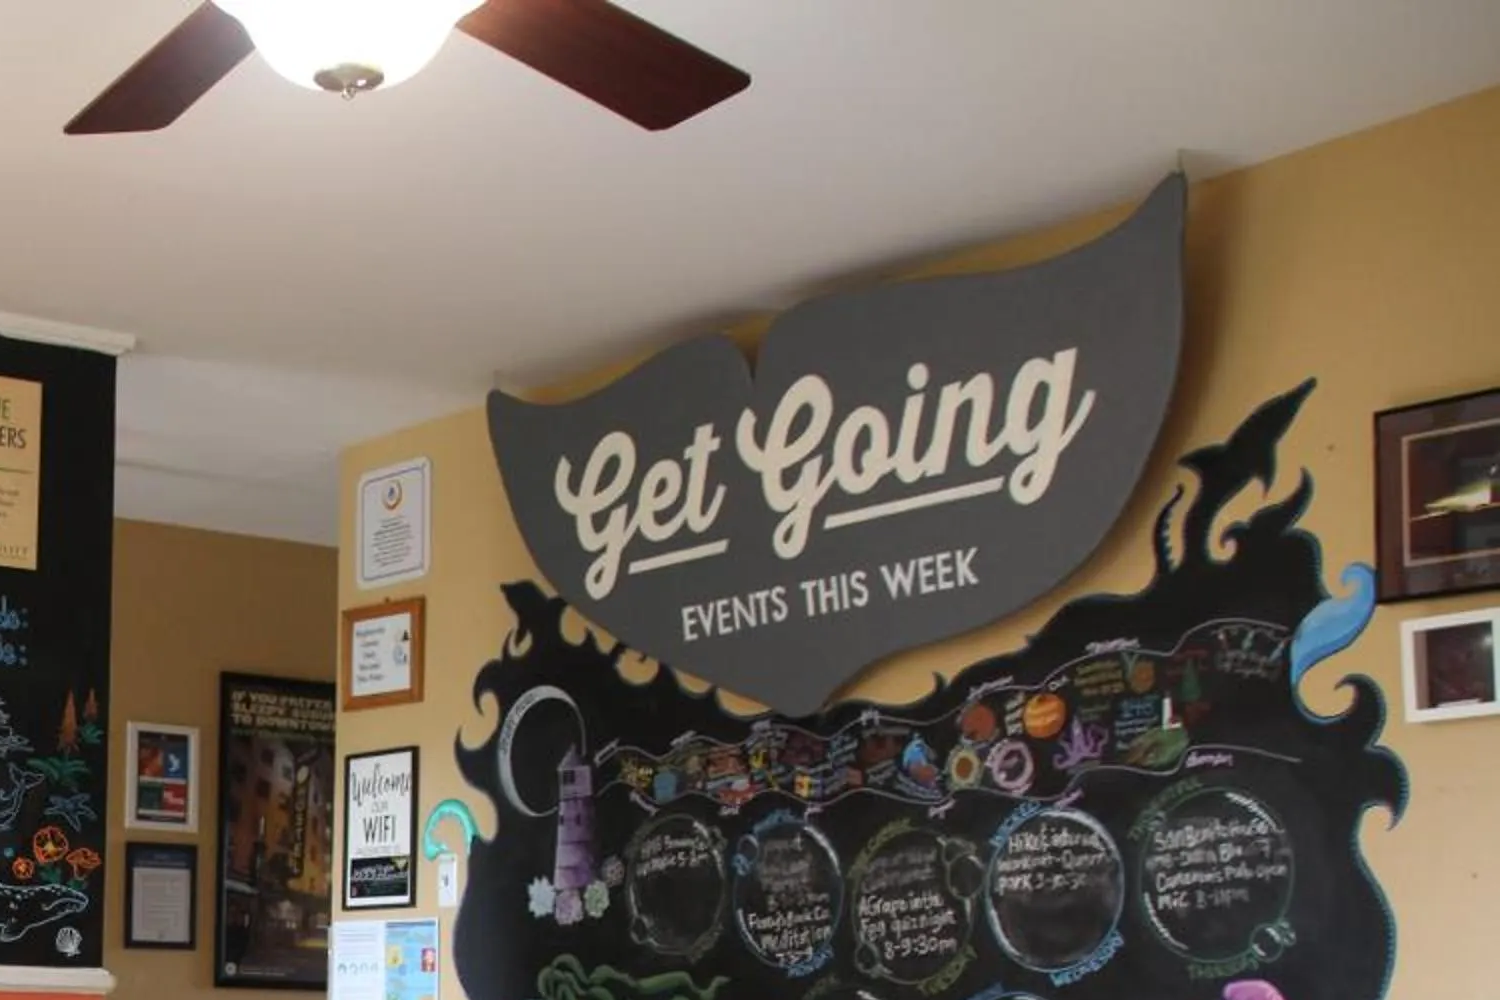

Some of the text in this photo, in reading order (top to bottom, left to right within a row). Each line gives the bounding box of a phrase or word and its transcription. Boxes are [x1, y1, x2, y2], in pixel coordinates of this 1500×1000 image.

[554, 346, 1096, 600] Get Going
[681, 547, 979, 642] EVENTS THIS WEEK
[363, 814, 396, 844] WIFI
